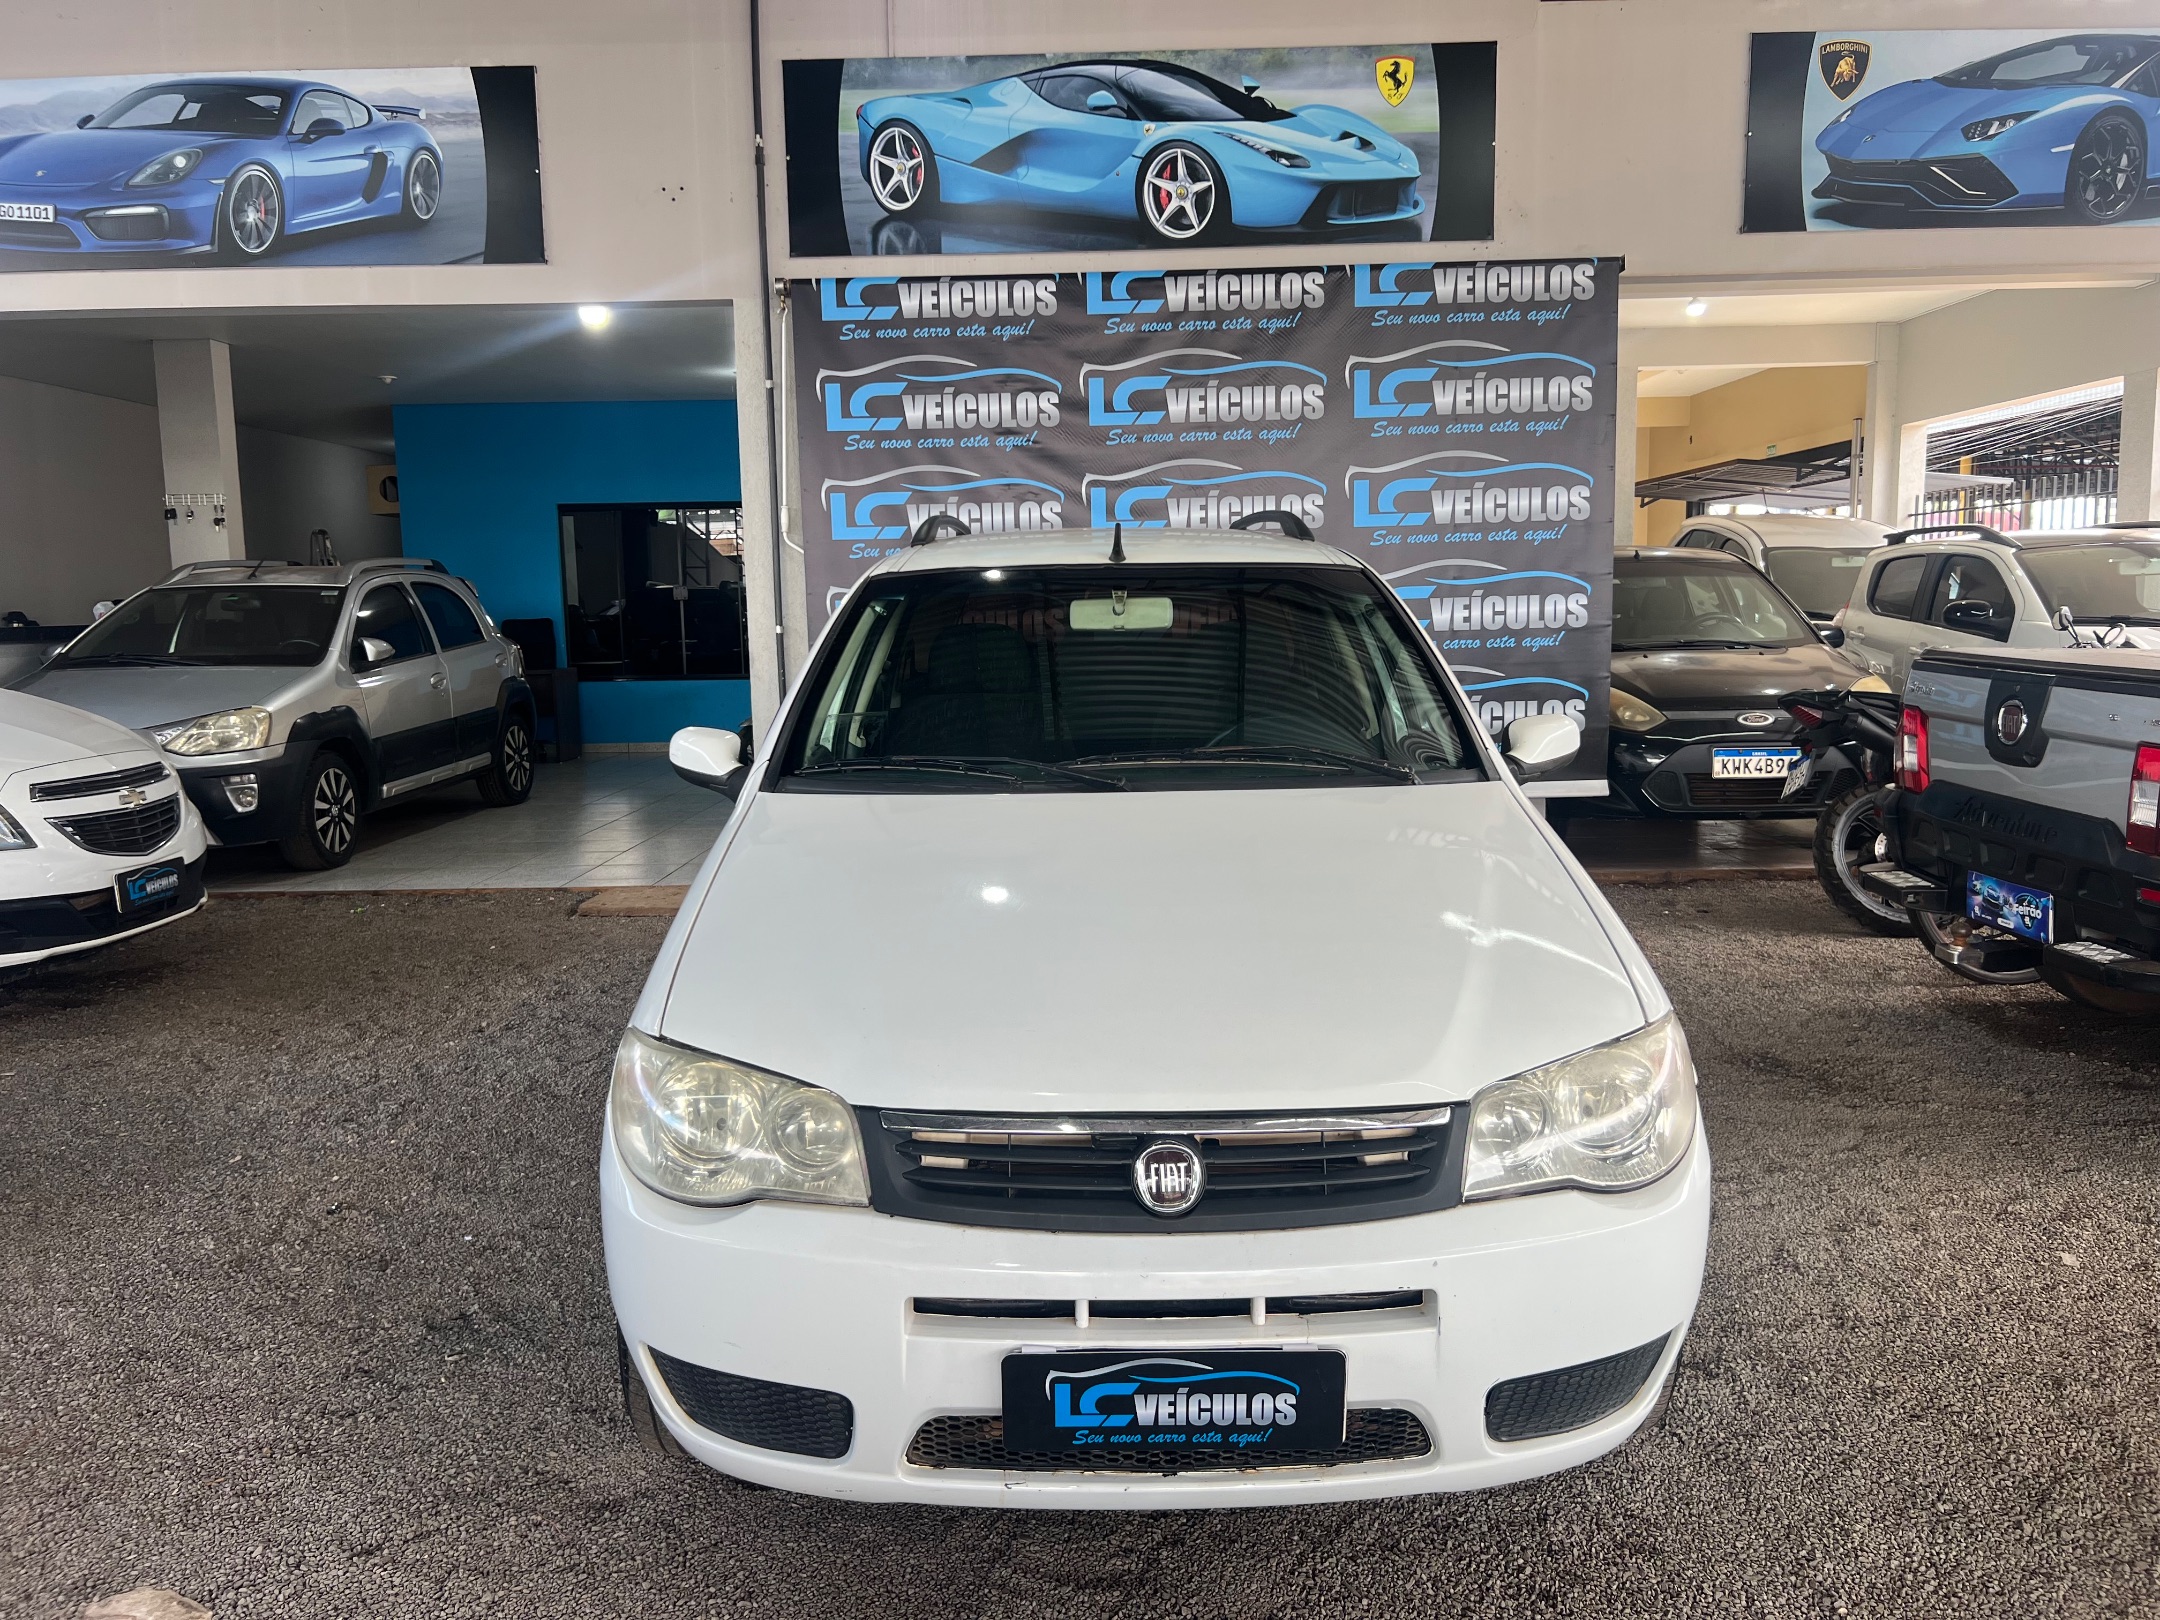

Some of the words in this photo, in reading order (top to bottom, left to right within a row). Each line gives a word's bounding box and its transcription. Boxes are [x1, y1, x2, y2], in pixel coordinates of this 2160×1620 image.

[1821, 42, 1868, 55] LAMBORGHINI
[1086, 270, 1168, 315] LC
[1164, 270, 1325, 312] VEÍCULOS
[1354, 262, 1438, 307] LC
[1433, 262, 1595, 304] VEÍCULOS
[820, 277, 901, 321] LC
[898, 278, 1058, 318] VEÍCULOS
[1104, 316, 1136, 335] Seu
[1141, 321, 1174, 332] novo
[1178, 319, 1217, 331] carro
[1222, 316, 1252, 330] esta
[1259, 311, 1303, 334] aqui!
[1372, 309, 1403, 327] Seu
[1409, 314, 1441, 323] novo
[1448, 312, 1485, 322] carro
[1491, 309, 1521, 321] esta
[1528, 304, 1571, 323] aqui!
[839, 323, 870, 341] Seu
[876, 328, 907, 338] novo
[913, 327, 952, 337] carro
[956, 324, 986, 337] esta
[992, 320, 1035, 340] aqui!
[825, 382, 908, 431] LC
[902, 387, 1060, 429] VEÍCULOS
[1088, 375, 1172, 426] LC
[1165, 380, 1325, 423] VEÍCULOS
[1353, 367, 1439, 419] LC
[1432, 371, 1593, 416] VEÍCULOS
[1105, 428, 1137, 446] Seu
[1142, 432, 1175, 443] novo
[1180, 431, 1218, 442] carro
[1222, 428, 1253, 441] esta
[1258, 423, 1302, 445] aqui!
[1371, 420, 1402, 438] Seu
[1408, 425, 1440, 434] novo
[1446, 423, 1485, 433] carro
[1490, 420, 1519, 433] esta
[1526, 416, 1569, 435] aqui!
[845, 433, 875, 451] Seu
[880, 439, 912, 449] novo
[917, 437, 955, 449] carro
[959, 435, 989, 448] esta
[996, 431, 1037, 451] aqui!
[830, 492, 912, 540] LC
[1353, 477, 1439, 528] LC
[1431, 482, 1591, 525] VEÍCULOS
[1370, 529, 1402, 547] Seu
[1407, 533, 1440, 544] novo
[1444, 532, 1483, 542] carro
[1487, 529, 1518, 542] esta
[1523, 524, 1568, 545] aqui!
[849, 542, 880, 560] Seu
[1430, 589, 1588, 632] VEÍCULOS
[1443, 639, 1482, 650] carro
[1486, 635, 1516, 649] esta
[1521, 631, 1566, 652] aqui!
[1151, 1162, 1188, 1193] FIAT
[1054, 1382, 1141, 1428] LC
[1134, 1387, 1298, 1426] VEÍCULOS
[1071, 1427, 1105, 1446] Seu
[1109, 1433, 1144, 1445] novo
[1147, 1432, 1188, 1444] carro
[1191, 1430, 1224, 1445] esta
[1228, 1426, 1274, 1449] aqui!
